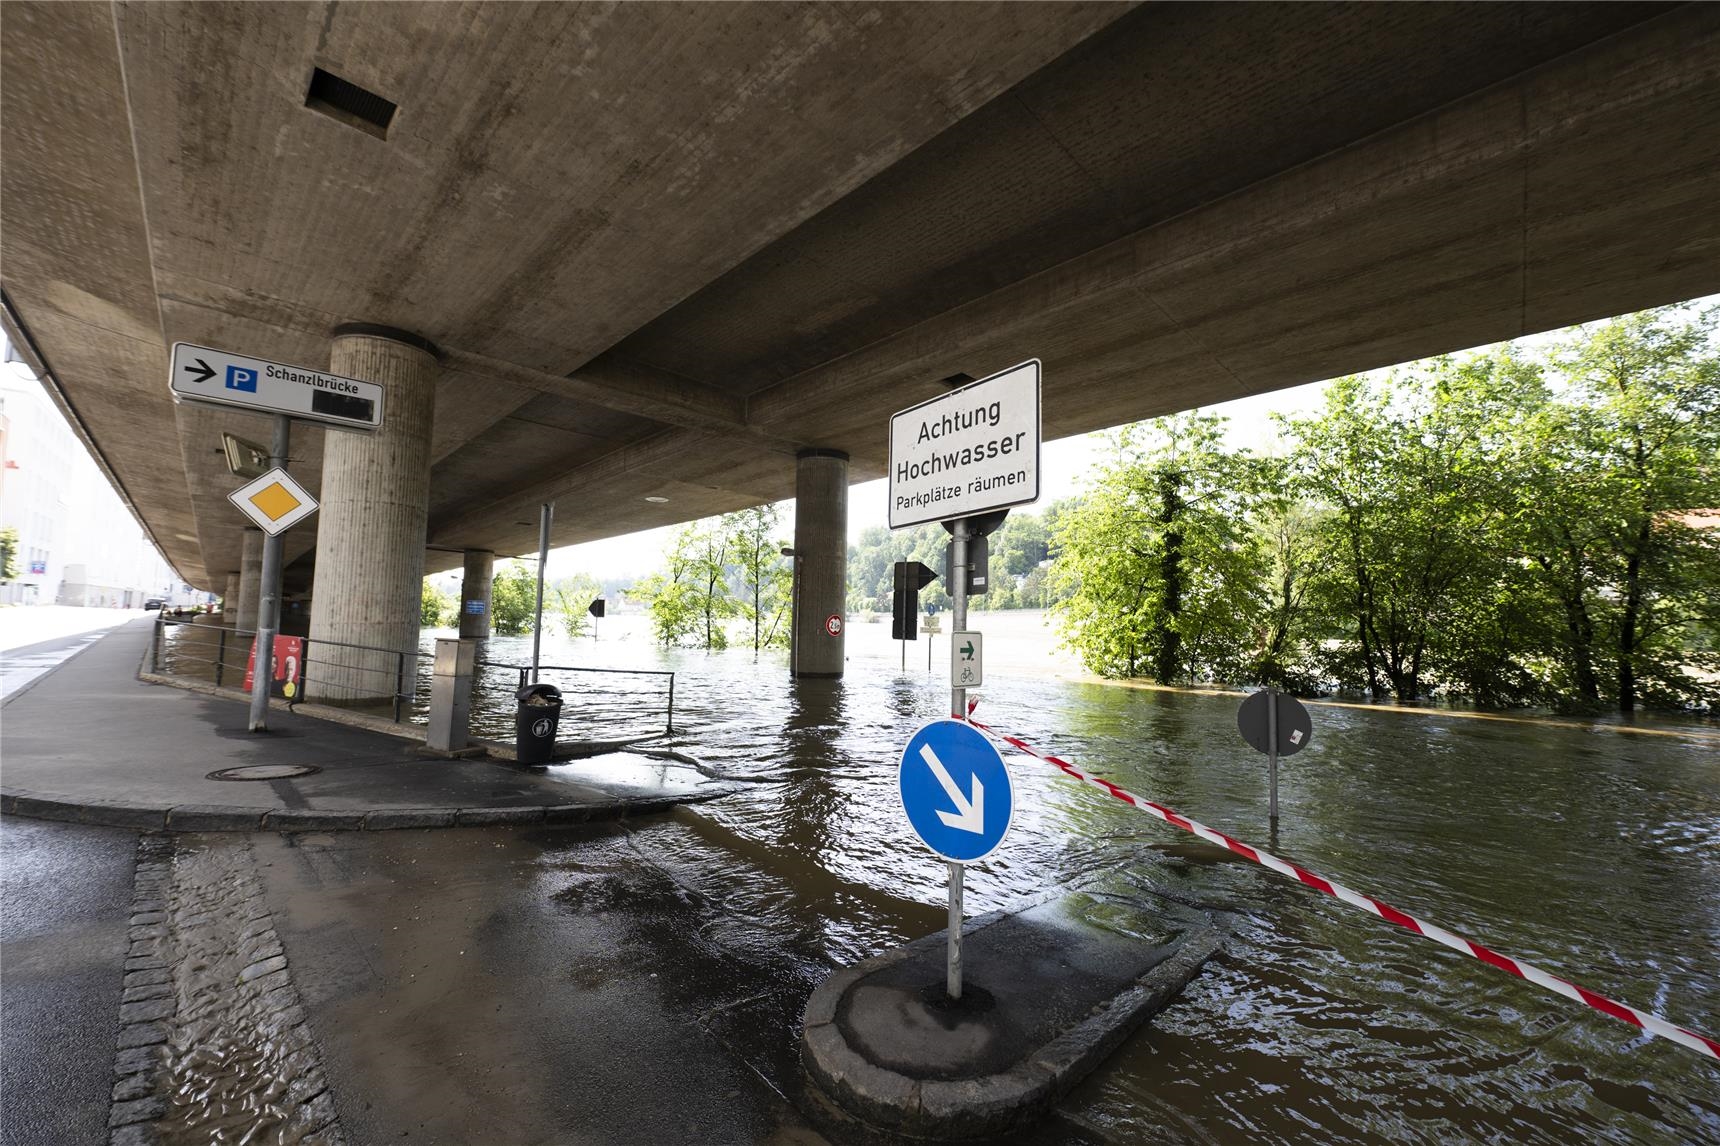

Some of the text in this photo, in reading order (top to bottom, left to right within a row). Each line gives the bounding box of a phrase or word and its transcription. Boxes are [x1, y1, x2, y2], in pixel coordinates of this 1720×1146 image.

[233, 365, 359, 394] P Schanzlbrücke
[917, 400, 1001, 444] Achtung
[897, 431, 1026, 483] Hochwasser
[896, 469, 1026, 510] Parkplätze räumen
